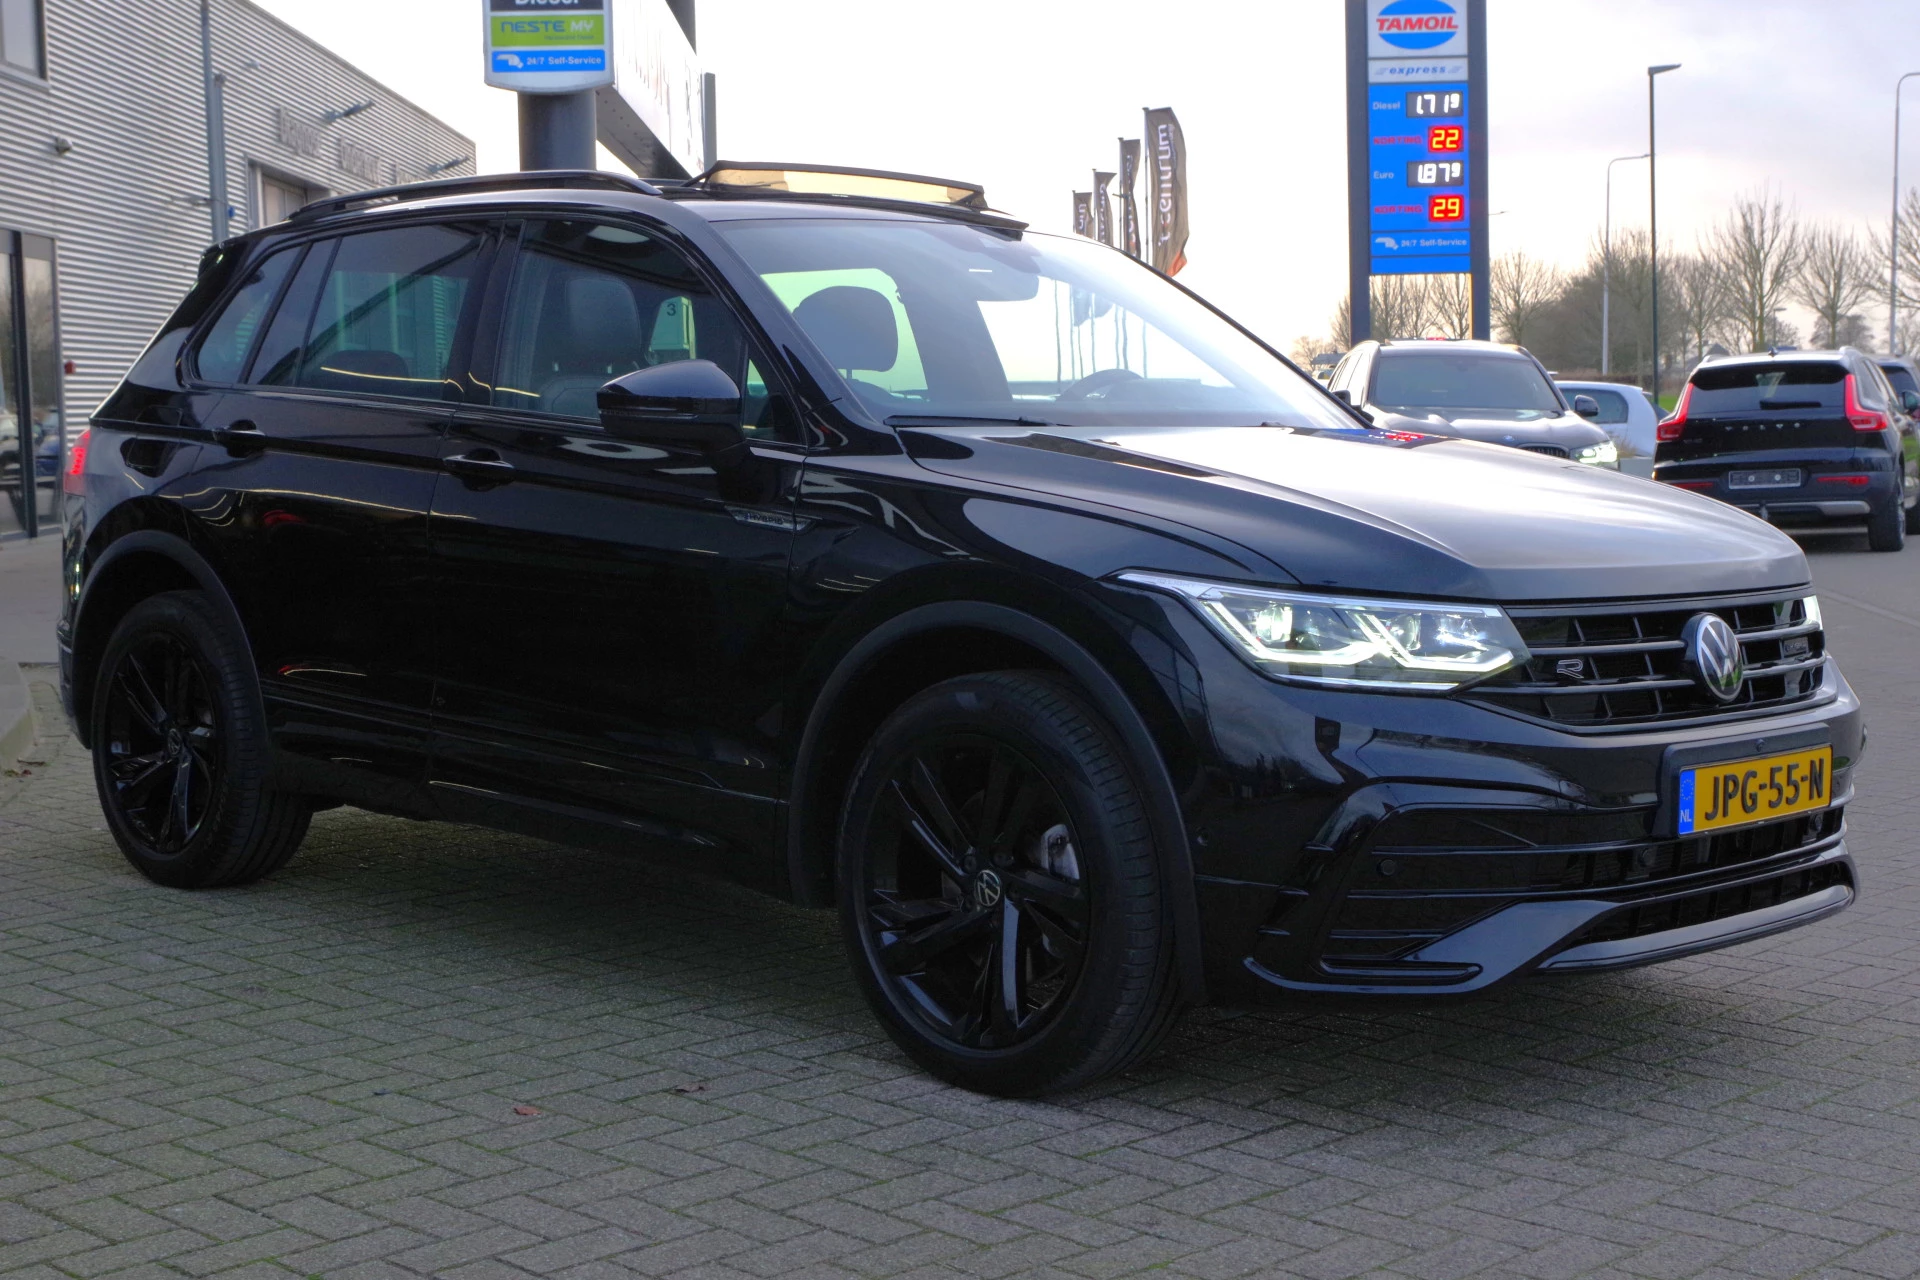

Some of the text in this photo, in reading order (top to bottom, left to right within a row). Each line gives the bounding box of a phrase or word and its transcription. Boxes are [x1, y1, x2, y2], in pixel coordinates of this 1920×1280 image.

[570, 20, 594, 33] MY
[1376, 16, 1459, 31] TAMOIL
[548, 56, 601, 65] Self-Service
[1389, 66, 1446, 76] express
[1372, 101, 1401, 110] Diesel
[1432, 129, 1459, 149] 22
[1373, 171, 1395, 180] Euro
[1433, 198, 1460, 218] 29
[1420, 238, 1467, 247] Self-Service
[666, 303, 677, 317] 3
[1704, 757, 1825, 821] JPG-55-N
[1679, 809, 1693, 823] NL
